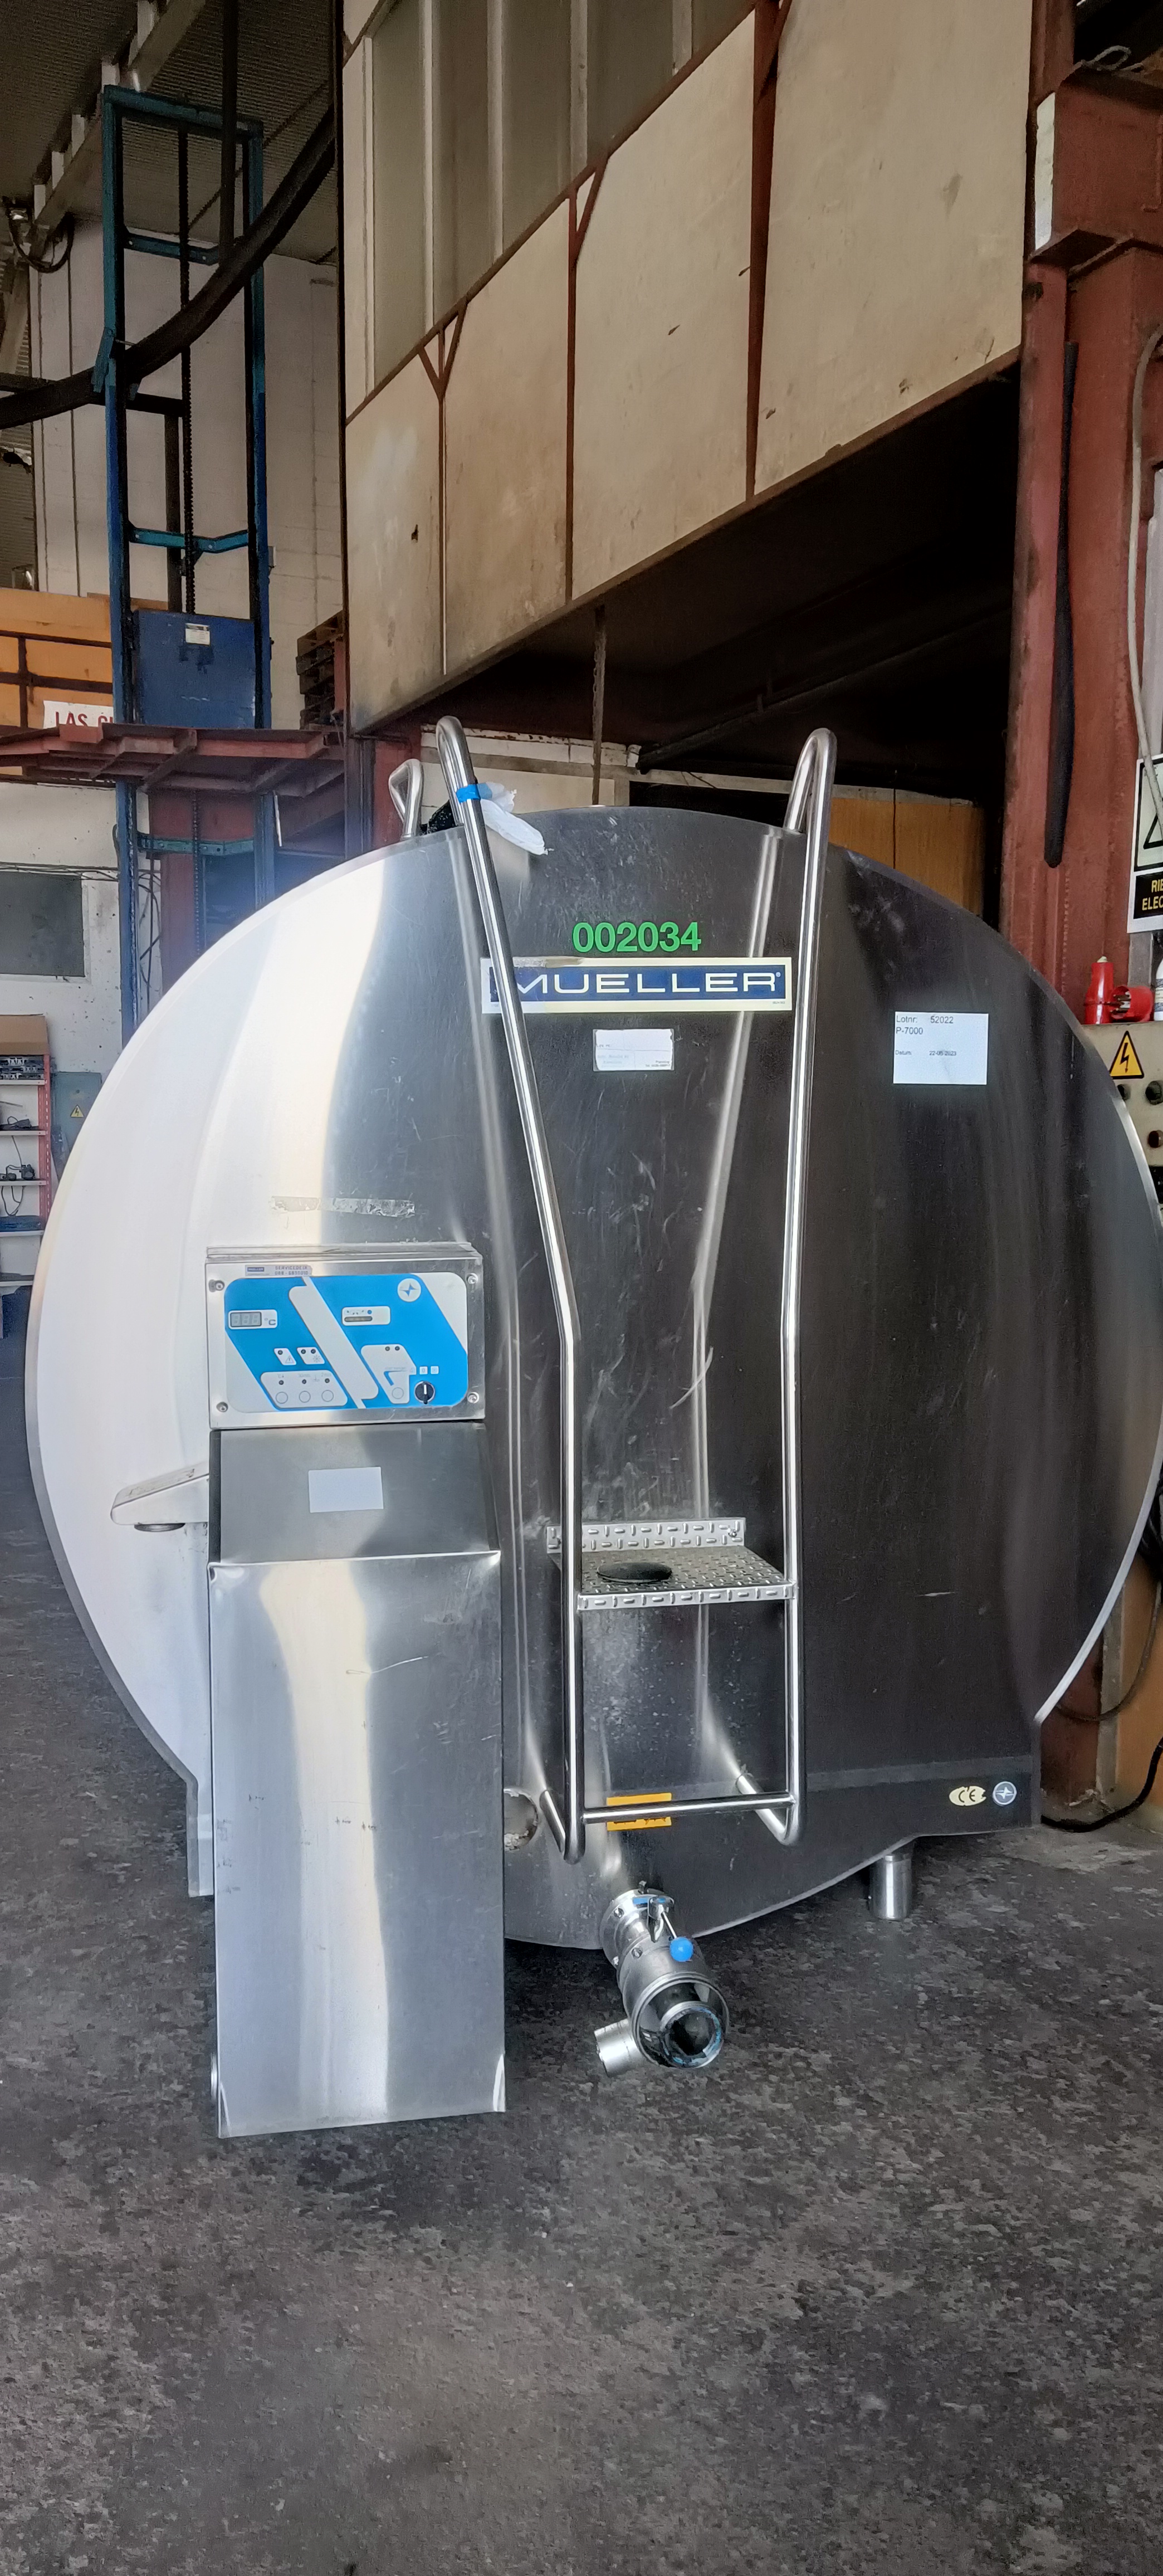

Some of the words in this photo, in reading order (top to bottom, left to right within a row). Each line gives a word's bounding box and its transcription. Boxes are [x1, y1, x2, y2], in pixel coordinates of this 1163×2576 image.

[1142, 895, 1163, 910] ELEC
[573, 922, 701, 953] 002034
[930, 1016, 954, 1024] 52022
[958, 1789, 976, 1803] CE
